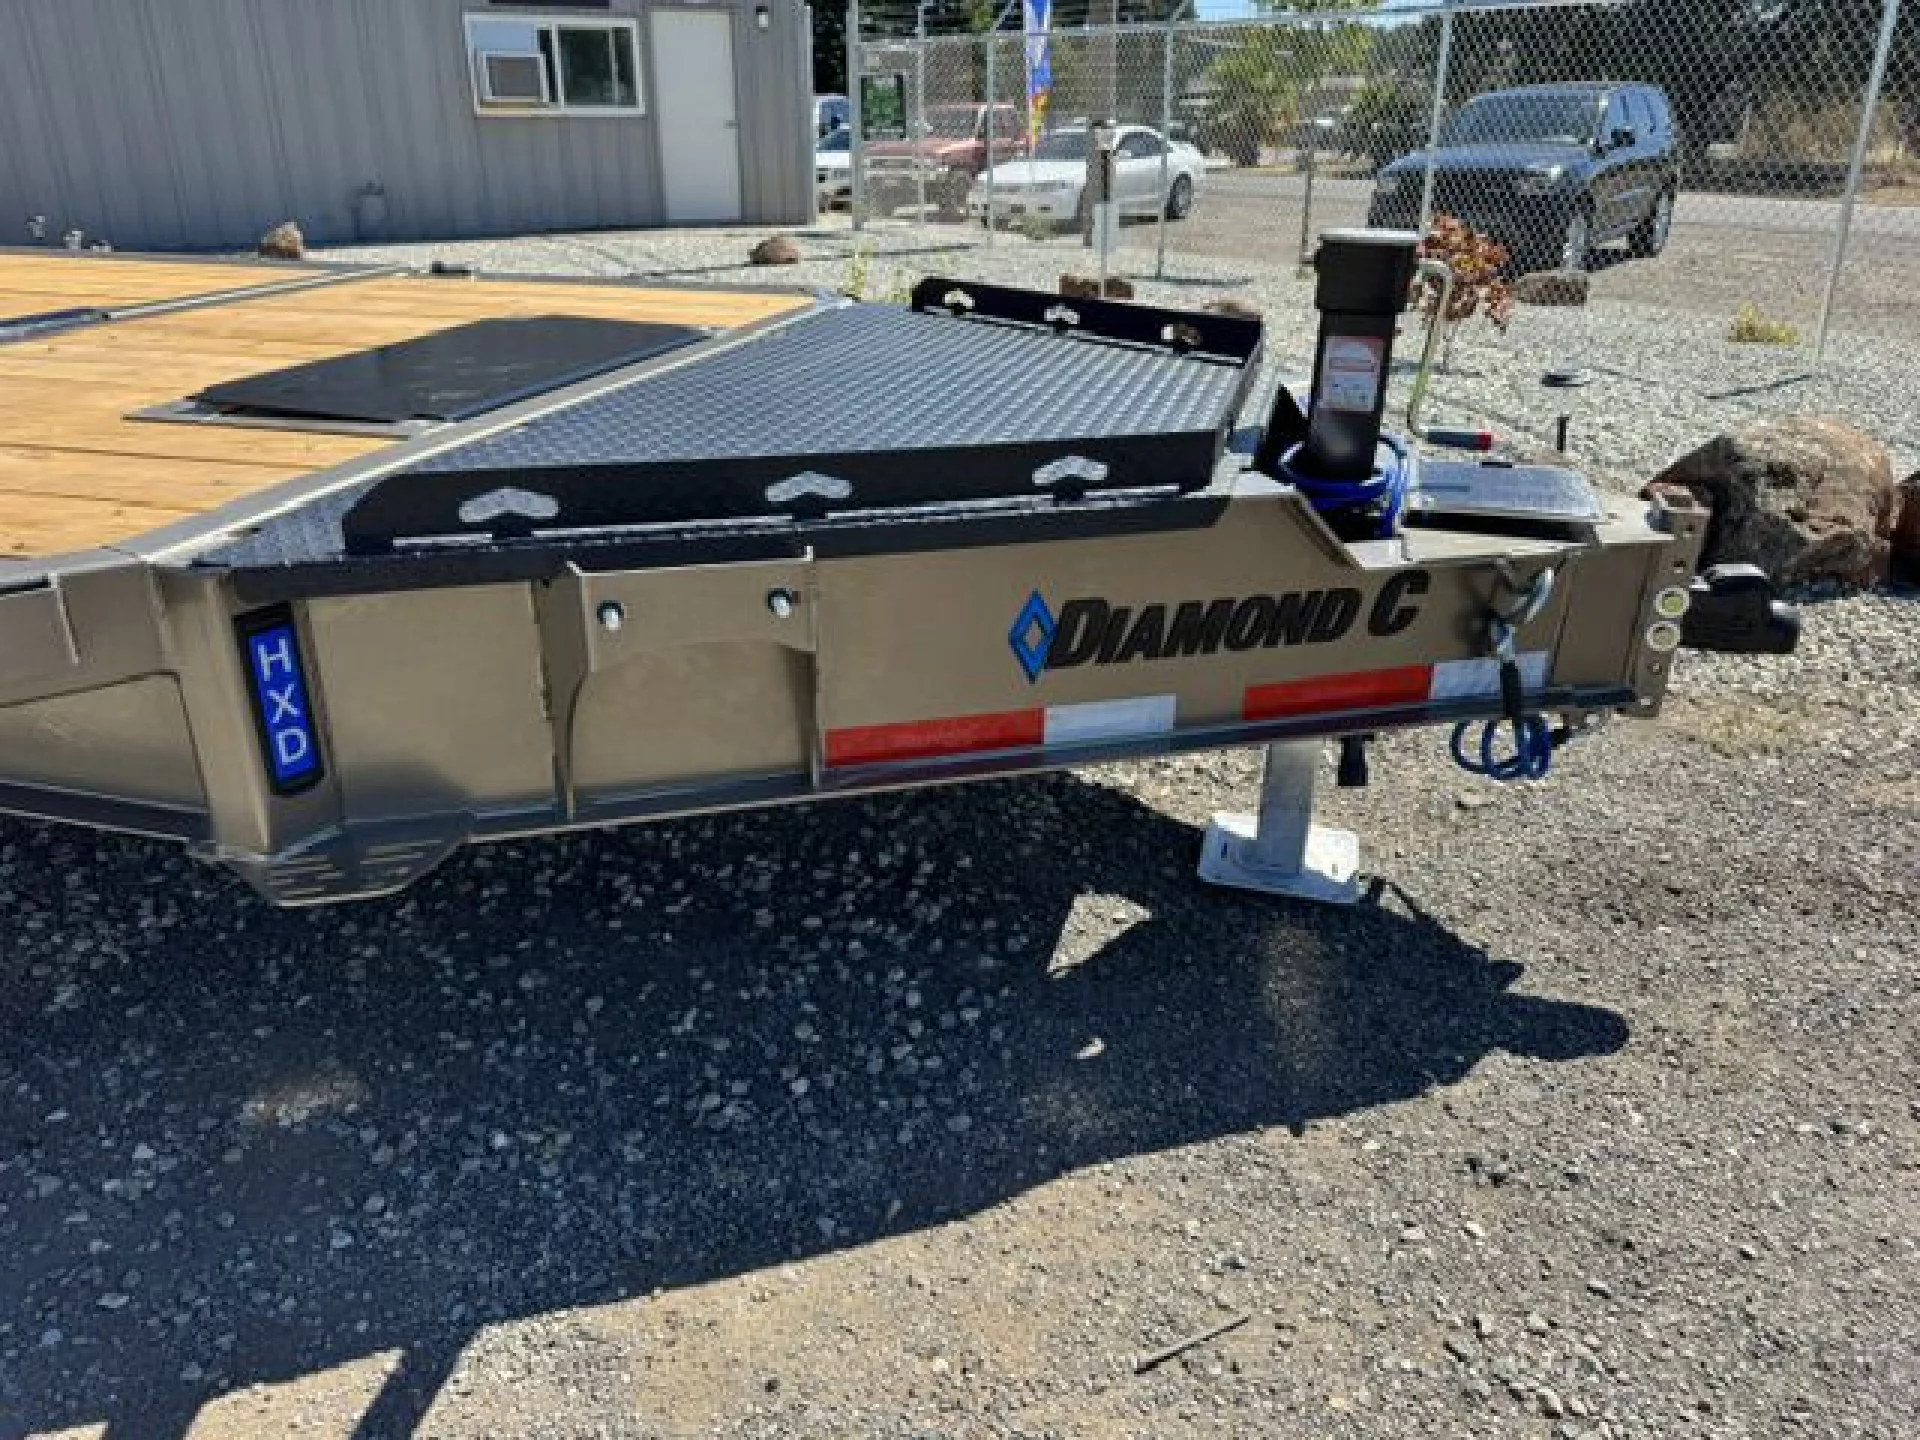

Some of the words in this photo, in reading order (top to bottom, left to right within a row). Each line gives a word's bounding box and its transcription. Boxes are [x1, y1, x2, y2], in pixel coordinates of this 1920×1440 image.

[1044, 587, 1363, 669] DIAMOND
[1367, 569, 1431, 637] C
[257, 637, 307, 766] HXD
